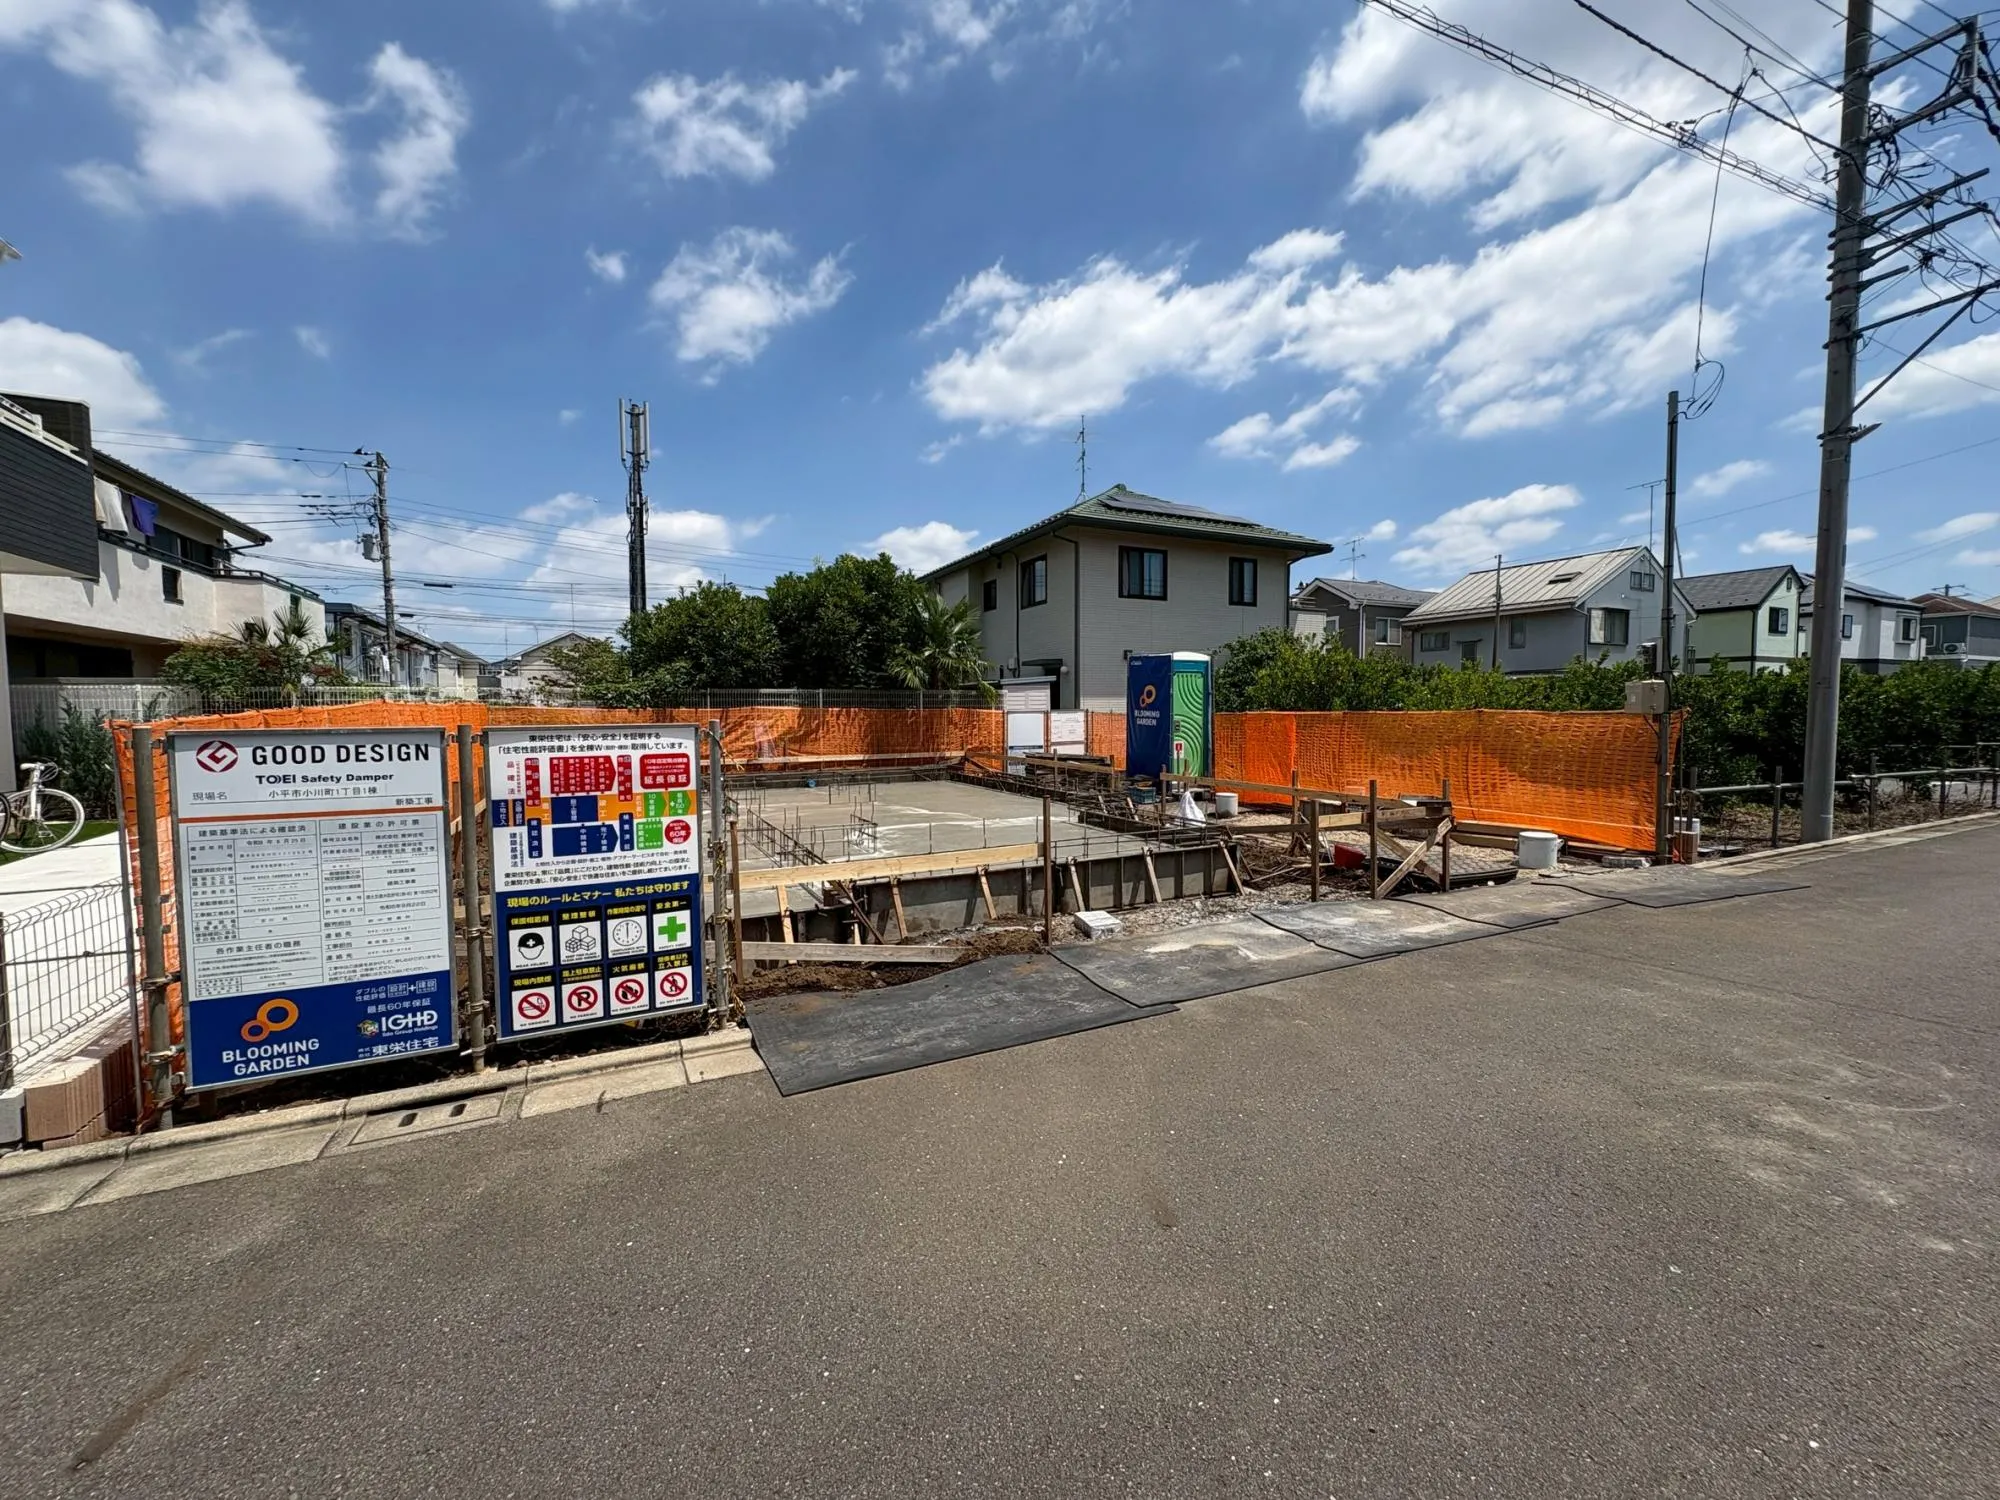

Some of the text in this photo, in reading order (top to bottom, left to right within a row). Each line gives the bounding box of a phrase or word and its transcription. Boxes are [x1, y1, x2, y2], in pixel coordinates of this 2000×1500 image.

[1134, 710, 1160, 718] BLOOMING
[1136, 718, 1157, 726] GARDEN
[528, 732, 661, 743] 東栄住宅は、「安心・安全」を証明する
[252, 743, 430, 766] GOOD DESIGN
[301, 774, 342, 785] Safety
[346, 772, 394, 783] Damper
[192, 791, 228, 802] 現場名
[268, 787, 378, 799] 小平市小川町1丁目1棟
[395, 796, 434, 807] 新築工事
[498, 801, 508, 826] 土地仕入
[338, 819, 420, 830] 建設業の許可票
[198, 825, 306, 838] 建築基準法による確認済
[506, 880, 690, 908] 現場のルールとマナー 私たちは守ります
[656, 900, 688, 911] 安全第一
[561, 910, 597, 921] 整理整頓
[215, 940, 301, 955] 各作業主任者の職務
[612, 962, 645, 974] 火気厳禁
[658, 960, 689, 970] 立入禁止
[355, 986, 386, 996] ダブルの
[367, 997, 432, 1014] 最長60年保証
[381, 1009, 438, 1032] IGHD
[222, 1038, 320, 1064] BLOOMING
[372, 1036, 439, 1057] 東栄住宅
[233, 1054, 310, 1076] GARDEN
